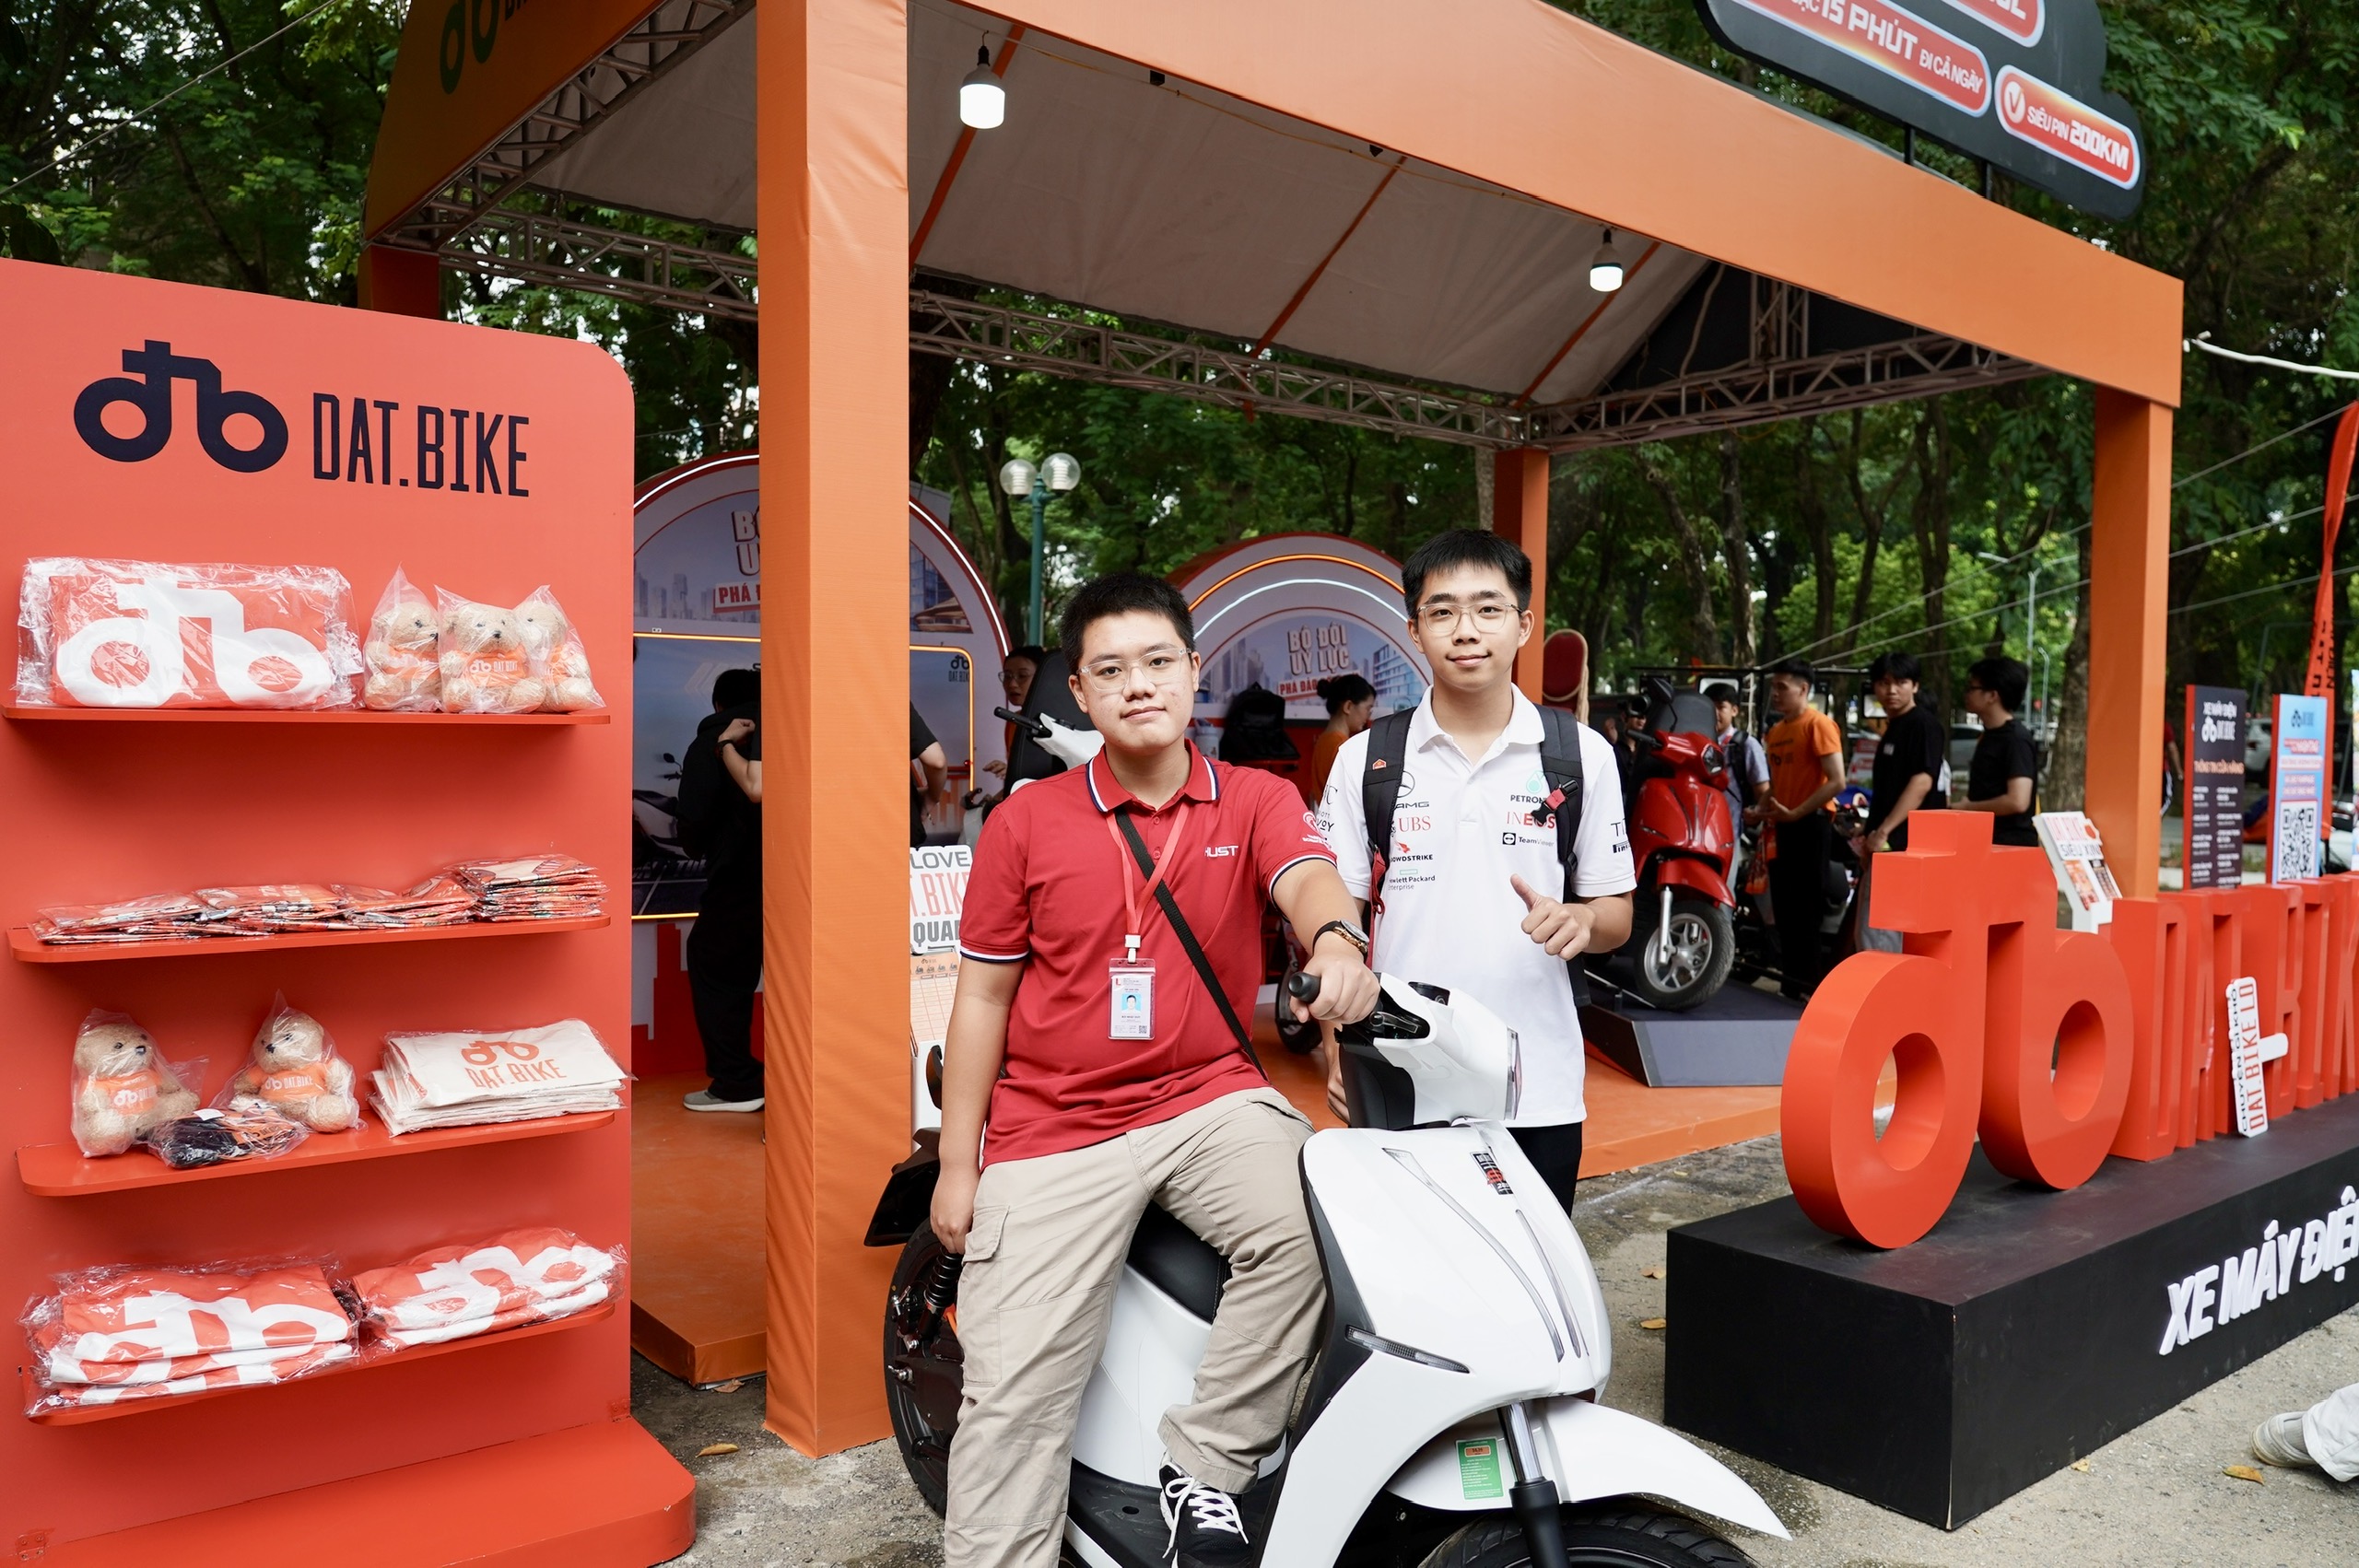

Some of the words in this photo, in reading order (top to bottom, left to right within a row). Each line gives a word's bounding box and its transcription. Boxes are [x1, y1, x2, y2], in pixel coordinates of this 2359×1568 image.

[1821, 0, 1846, 25] 15
[1848, 10, 1918, 60] PHÚT
[1933, 55, 1952, 80] CẢ
[1951, 64, 1984, 94] NGÀY
[2027, 105, 2052, 133] SIÊU
[2050, 122, 2071, 141] PIN
[2069, 120, 2130, 171] 200KM
[313, 392, 529, 497] DAT.BIKE
[719, 582, 752, 604] PHÁ
[1398, 815, 1431, 833] UBS
[910, 851, 970, 869] LOVE
[1391, 854, 1433, 863] OWDSTRIKE
[2239, 983, 2256, 1012] LO
[284, 1075, 313, 1090] DAT.BIKE
[464, 1059, 568, 1089] DAT.BIKE
[2241, 1018, 2265, 1130] DAT.BIKE
[2159, 1264, 2219, 1355] XE
[2218, 1219, 2302, 1325] MÁY
